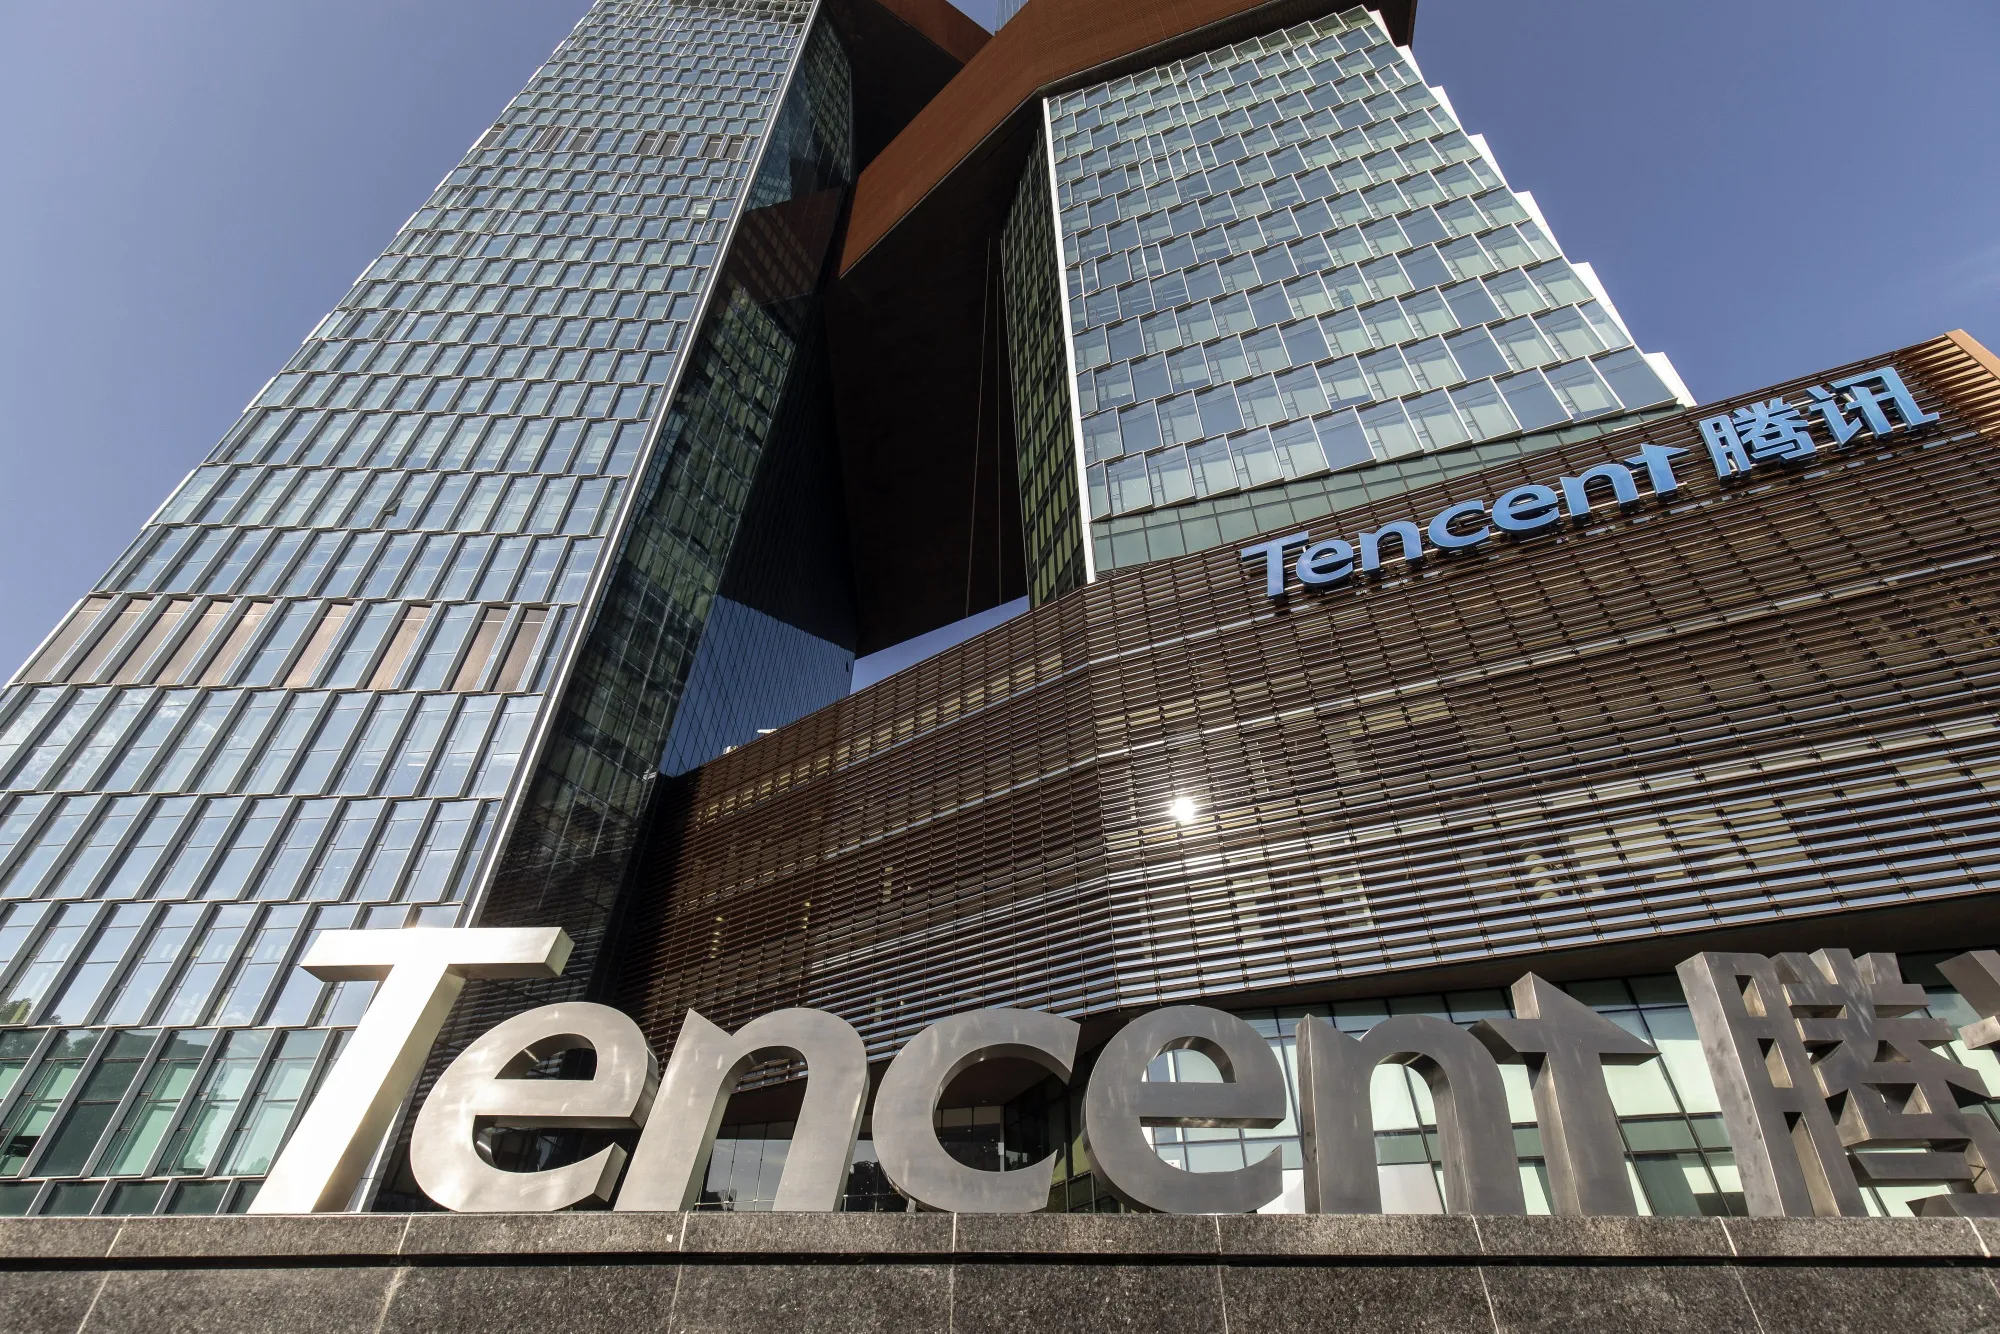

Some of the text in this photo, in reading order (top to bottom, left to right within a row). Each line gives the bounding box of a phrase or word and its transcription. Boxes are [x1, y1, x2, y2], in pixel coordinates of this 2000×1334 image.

[1241, 366, 1940, 599] Tencent 腾讯
[248, 927, 2000, 1217] Tencent 腾
